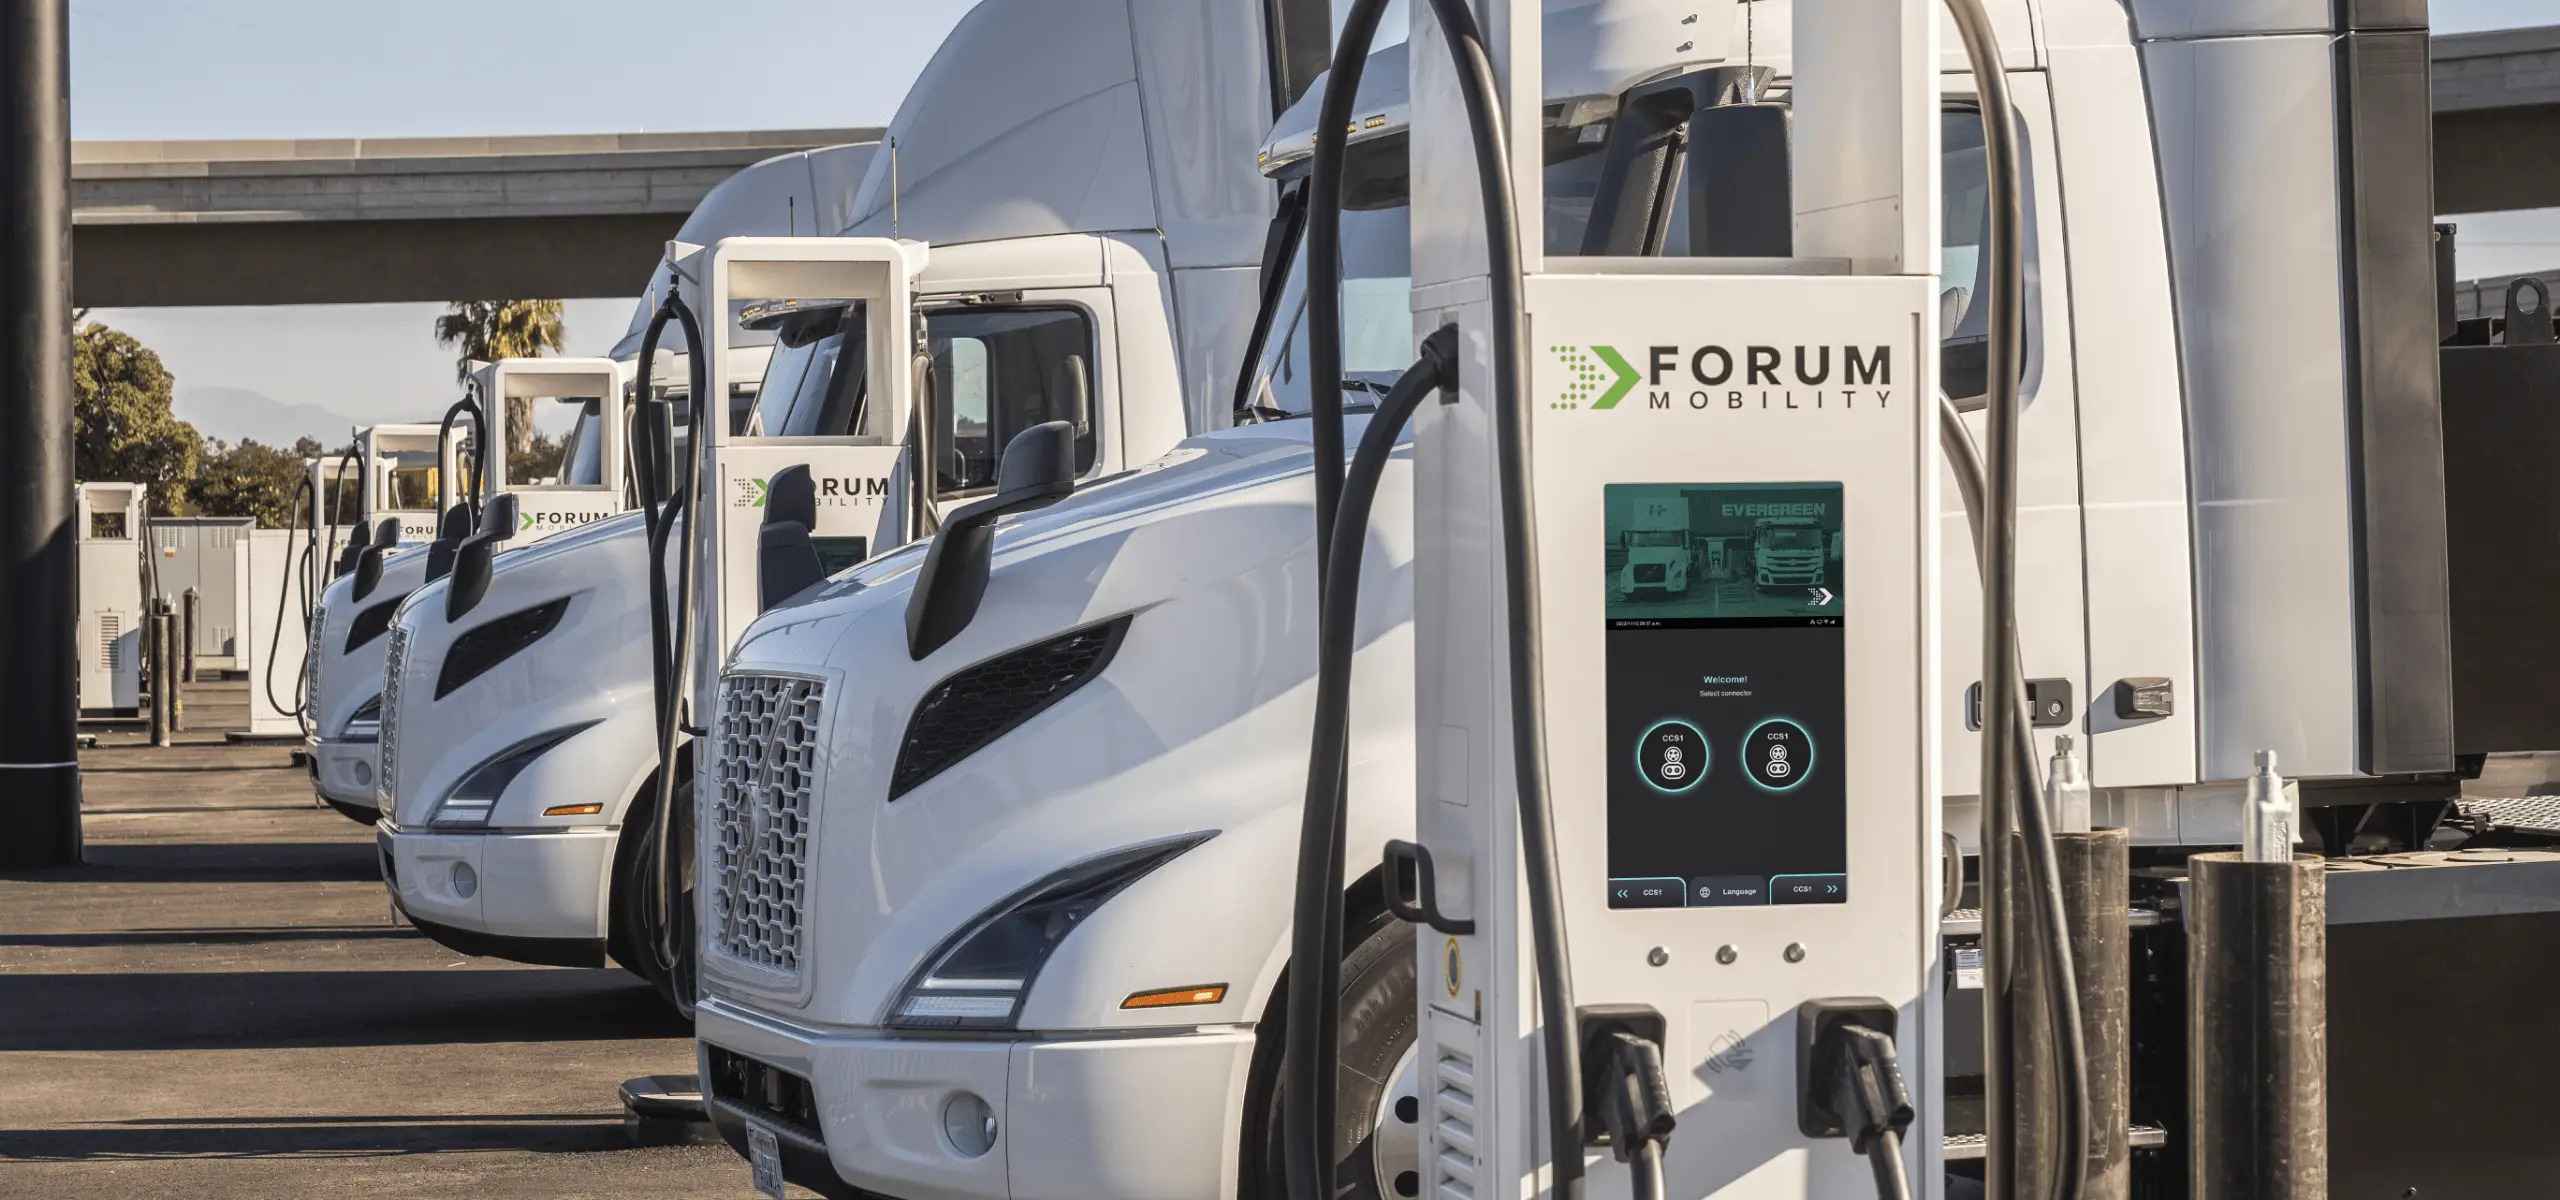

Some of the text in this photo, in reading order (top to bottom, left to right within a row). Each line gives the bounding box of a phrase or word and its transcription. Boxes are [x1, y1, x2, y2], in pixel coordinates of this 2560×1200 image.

[1649, 345, 1892, 386] FORUM
[1649, 390, 1892, 409] MOBILITY
[811, 477, 889, 496] RUM
[1721, 503, 1826, 517] EVERGREEN
[1703, 675, 1748, 684] Welcome!
[1662, 734, 1684, 743] CCS1
[1767, 732, 1789, 741] CCS1
[1723, 888, 1757, 897] Language
